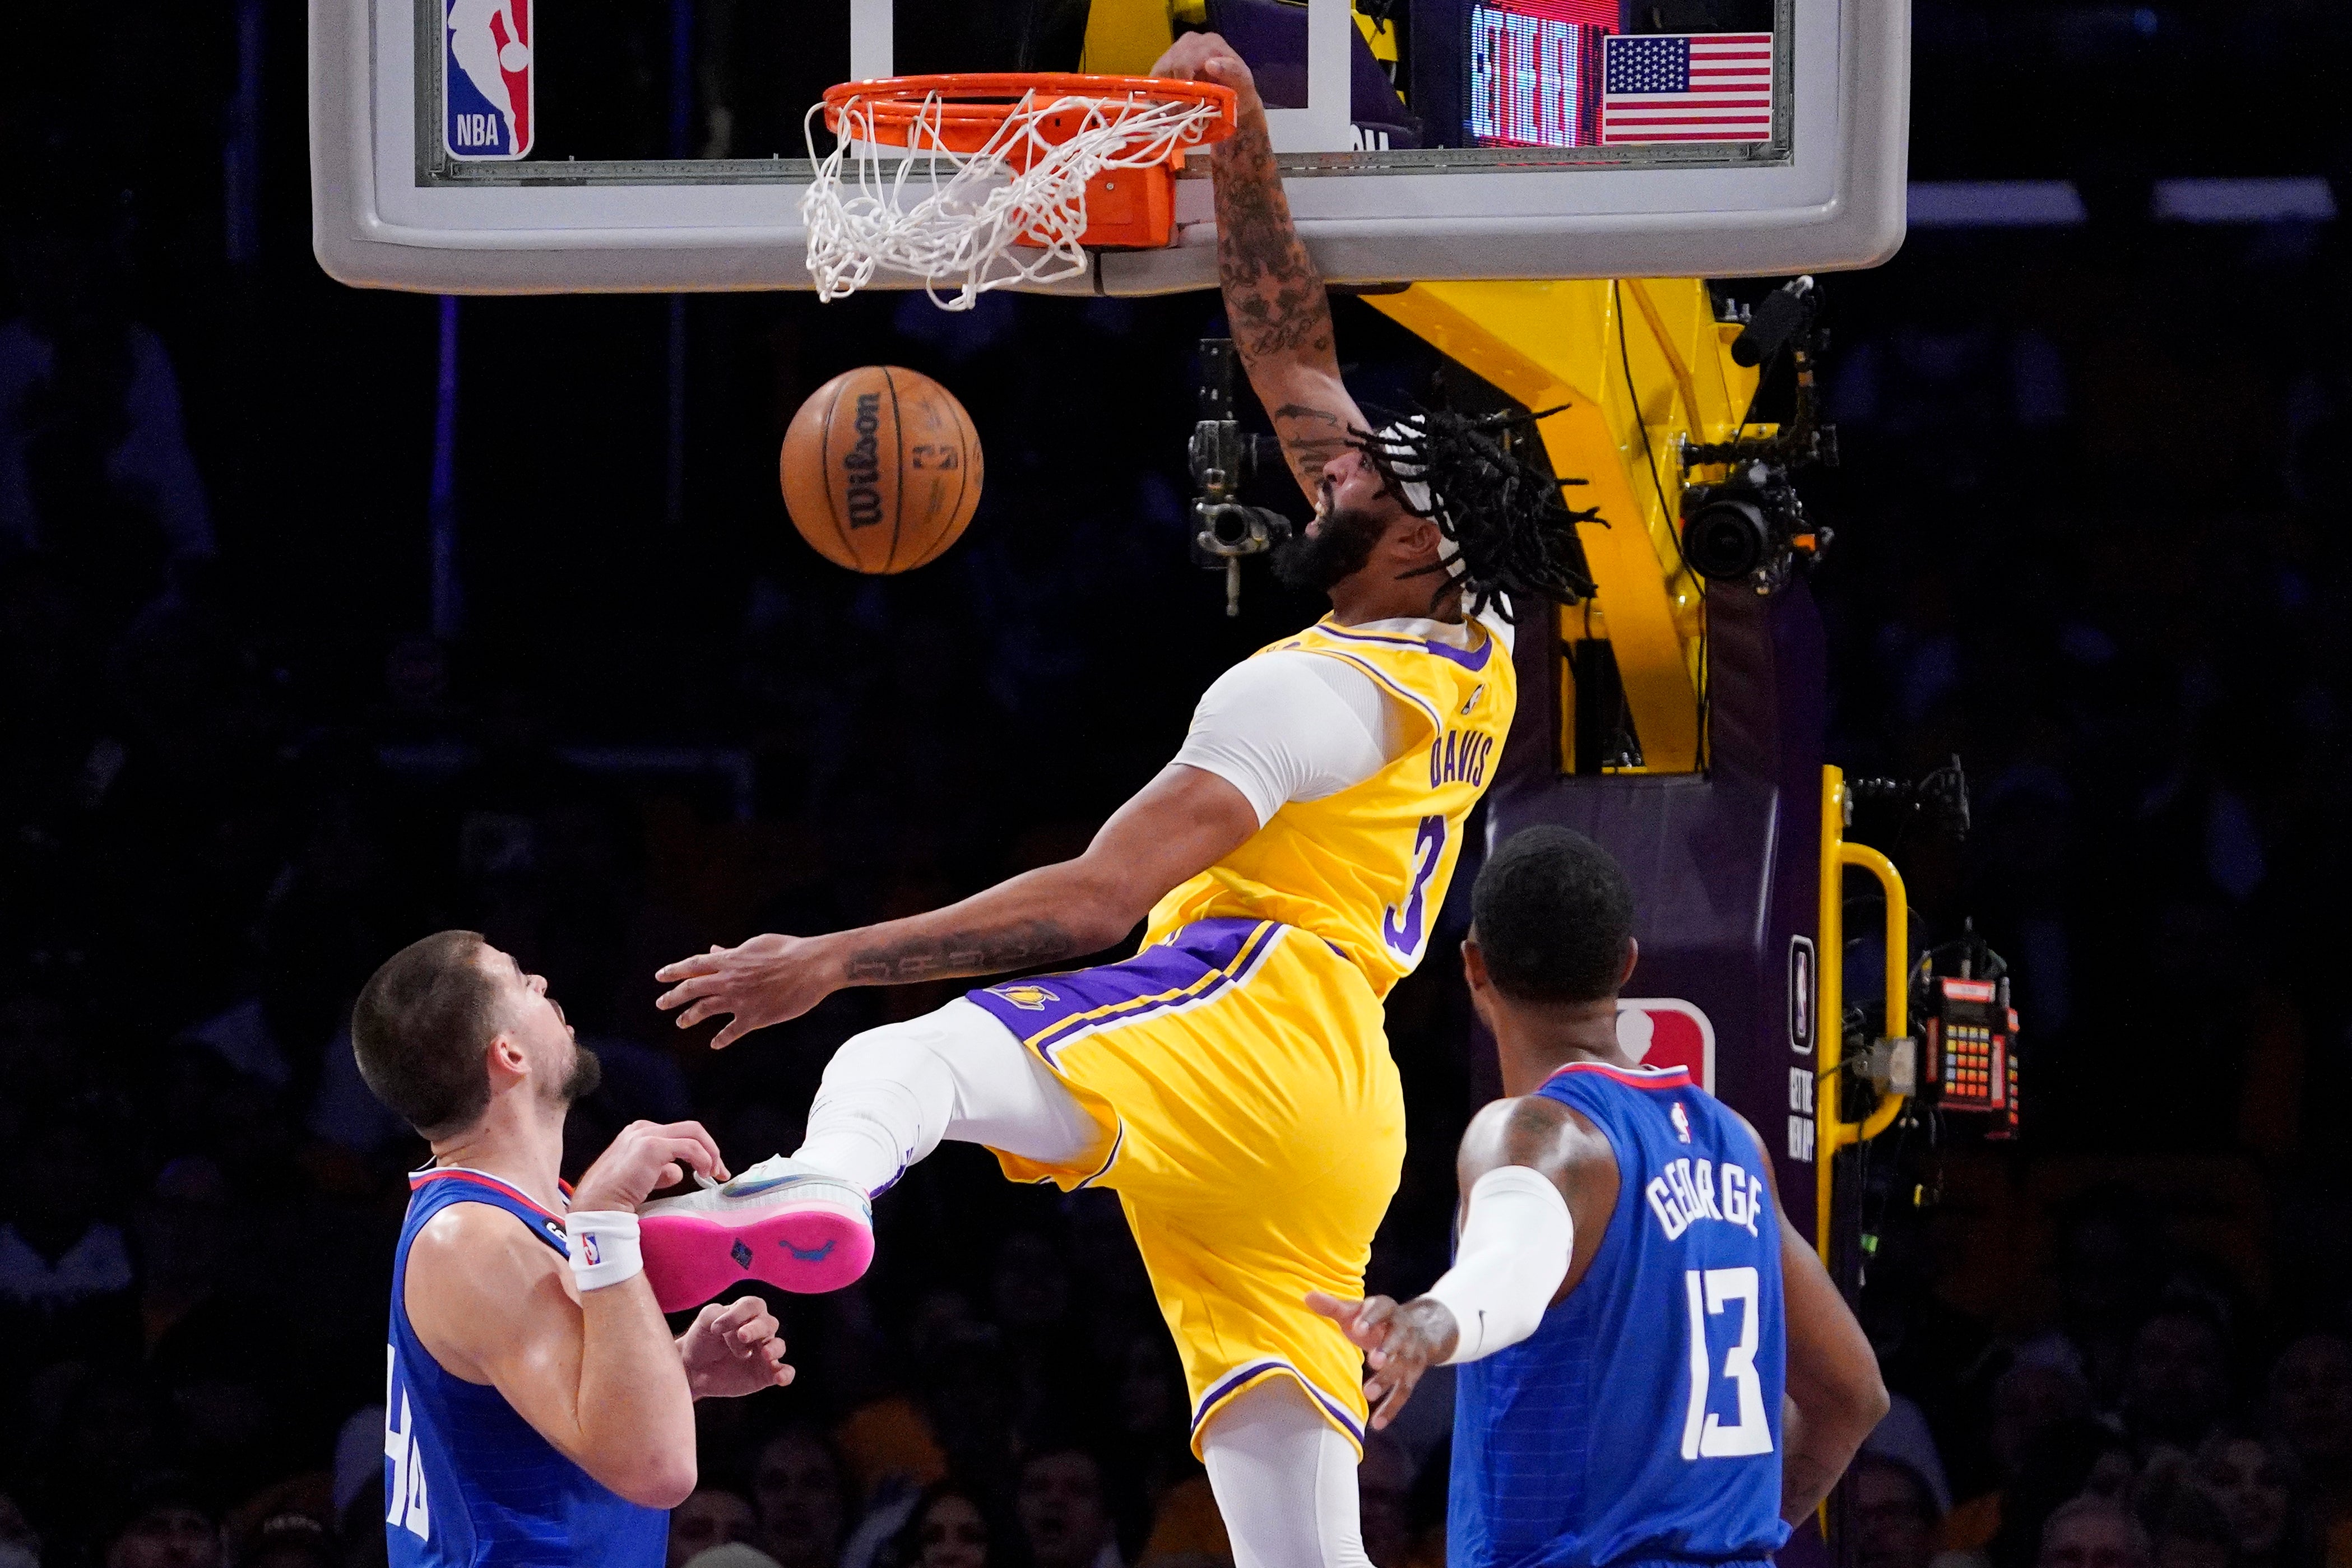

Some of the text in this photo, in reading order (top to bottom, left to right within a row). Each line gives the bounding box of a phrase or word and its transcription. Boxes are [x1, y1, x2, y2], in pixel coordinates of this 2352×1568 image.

[457, 114, 499, 146] NBA
[844, 392, 884, 530] Wilson
[1430, 730, 1493, 789] DAVIS
[1381, 814, 1449, 975] 3
[1645, 1158, 1763, 1241] GEORGE
[1682, 1267, 1775, 1459] 13
